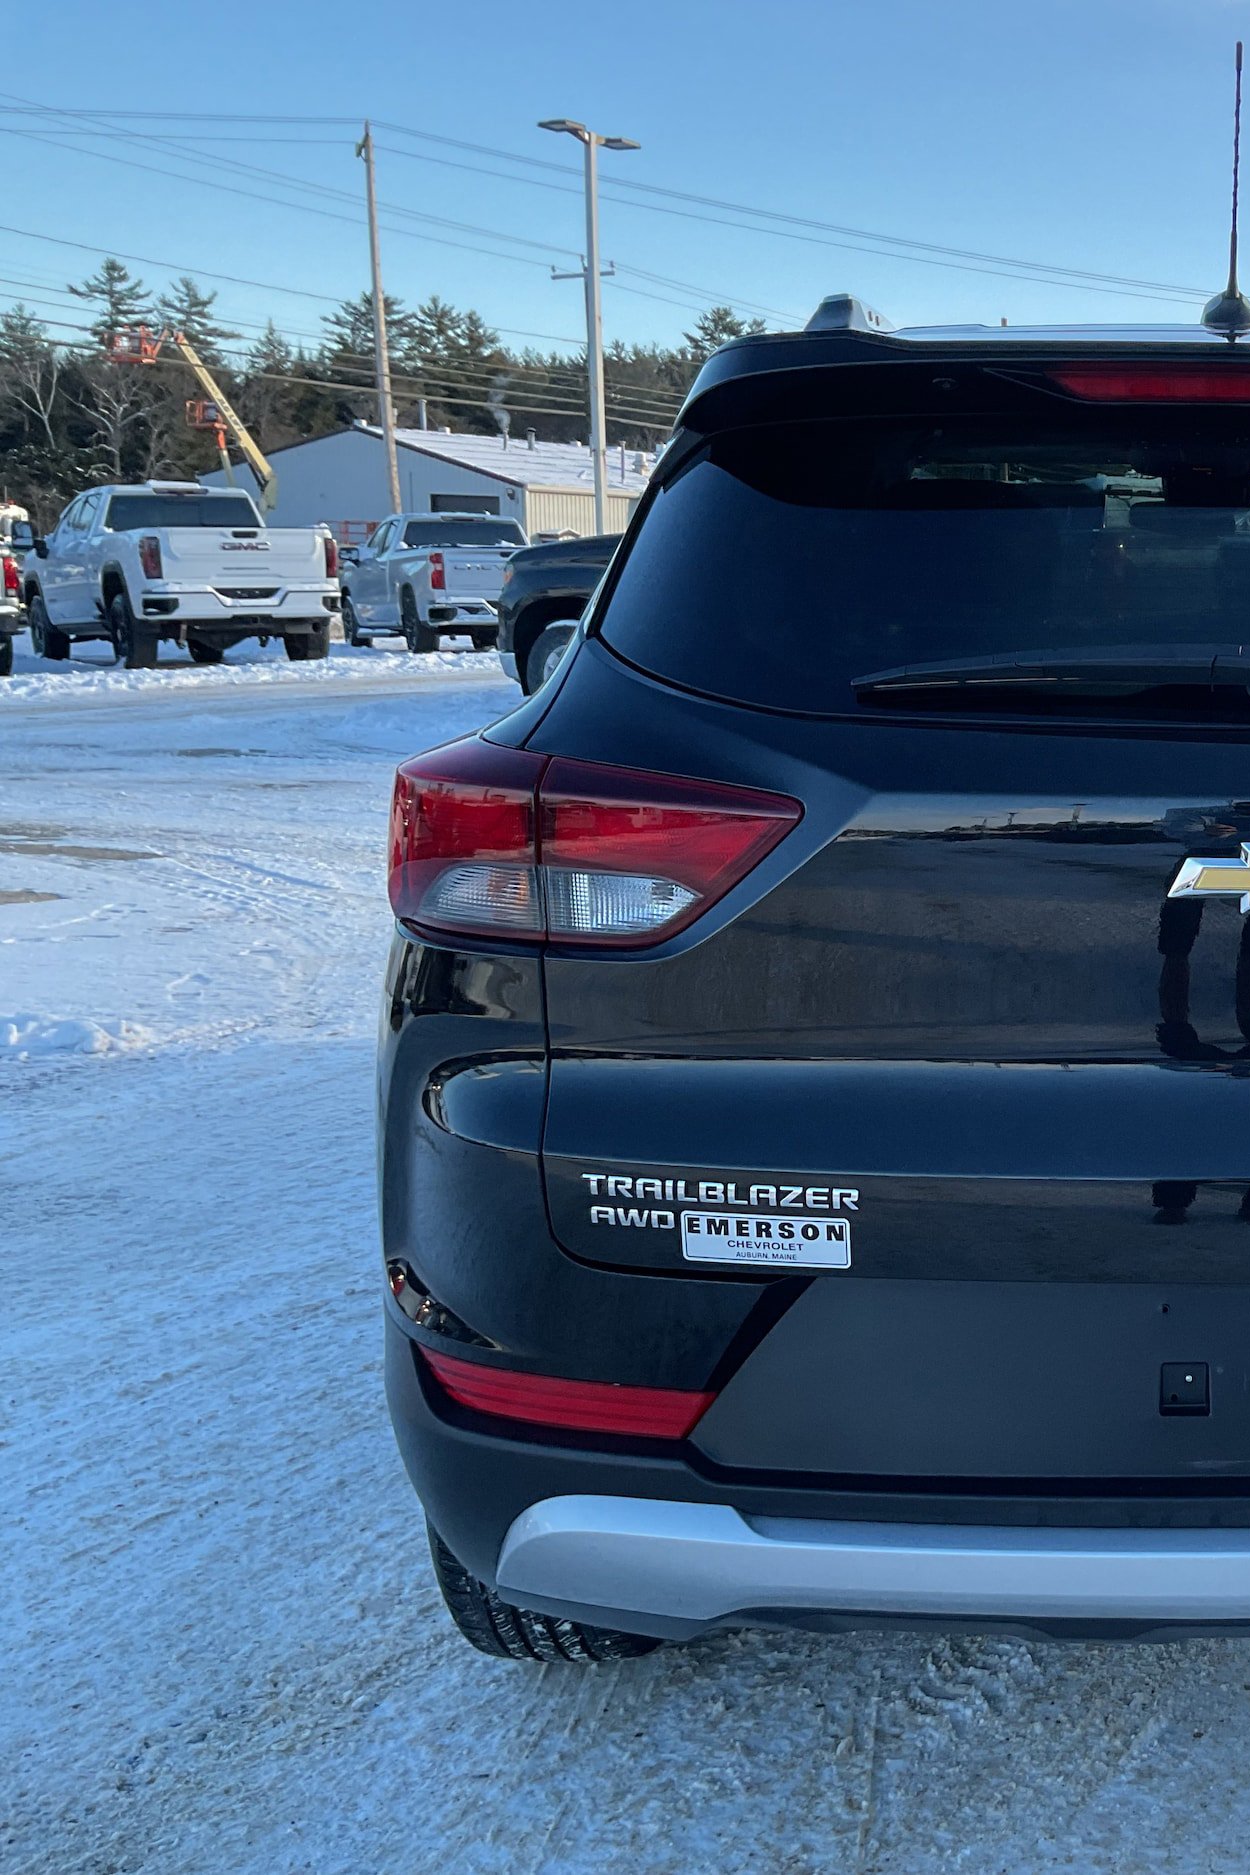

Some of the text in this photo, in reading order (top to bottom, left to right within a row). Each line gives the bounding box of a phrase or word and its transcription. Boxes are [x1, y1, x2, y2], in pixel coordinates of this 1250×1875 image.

[221, 542, 270, 551] GMC
[581, 1173, 860, 1211] TRAILBLAZER
[590, 1205, 675, 1230] AWD
[687, 1217, 845, 1242] EMERSON
[727, 1239, 804, 1252] CHEVROLET
[771, 1253, 797, 1261] MAINE
